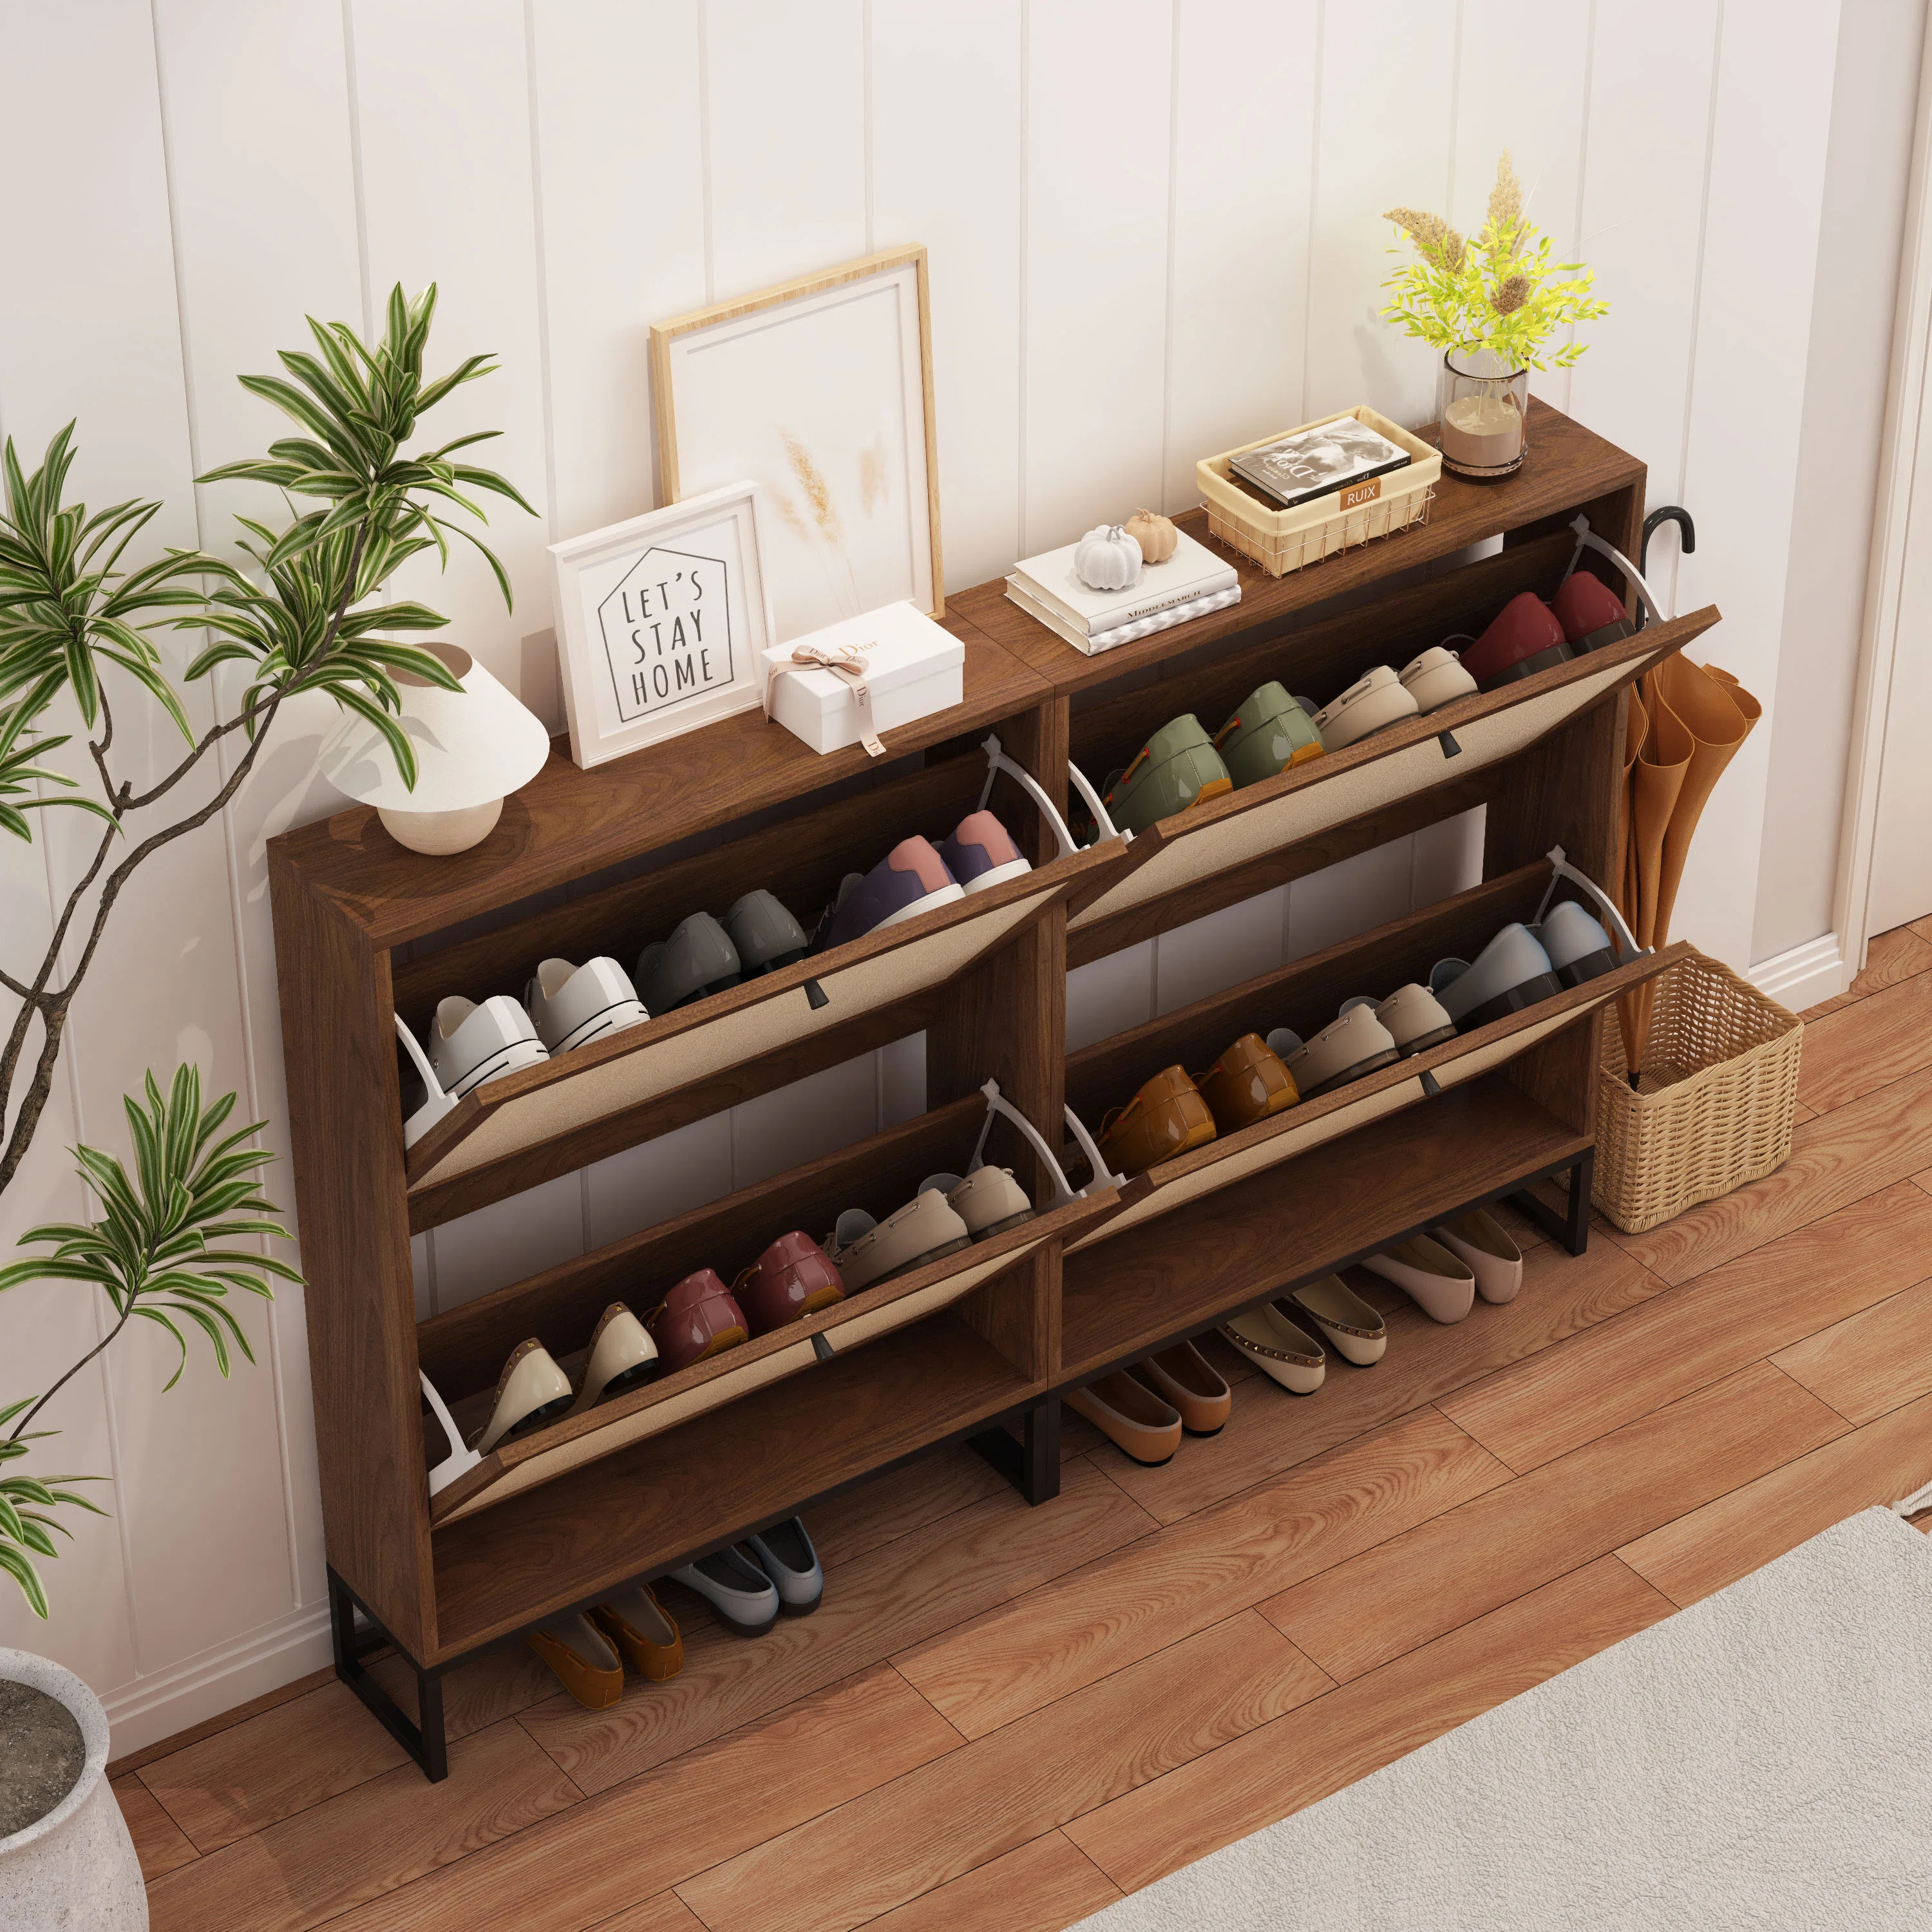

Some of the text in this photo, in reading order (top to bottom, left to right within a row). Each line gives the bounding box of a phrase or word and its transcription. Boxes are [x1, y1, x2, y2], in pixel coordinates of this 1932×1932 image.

[1347, 485, 1376, 506] RUIX
[622, 571, 703, 623] LET'S
[1128, 591, 1200, 618] MIDDLEMARCH
[631, 609, 702, 665] STAY
[809, 648, 826, 659] Dior
[837, 639, 878, 657] Dior
[845, 656, 863, 665] Dior
[632, 649, 714, 705] HOME
[857, 686, 867, 706] Dior
